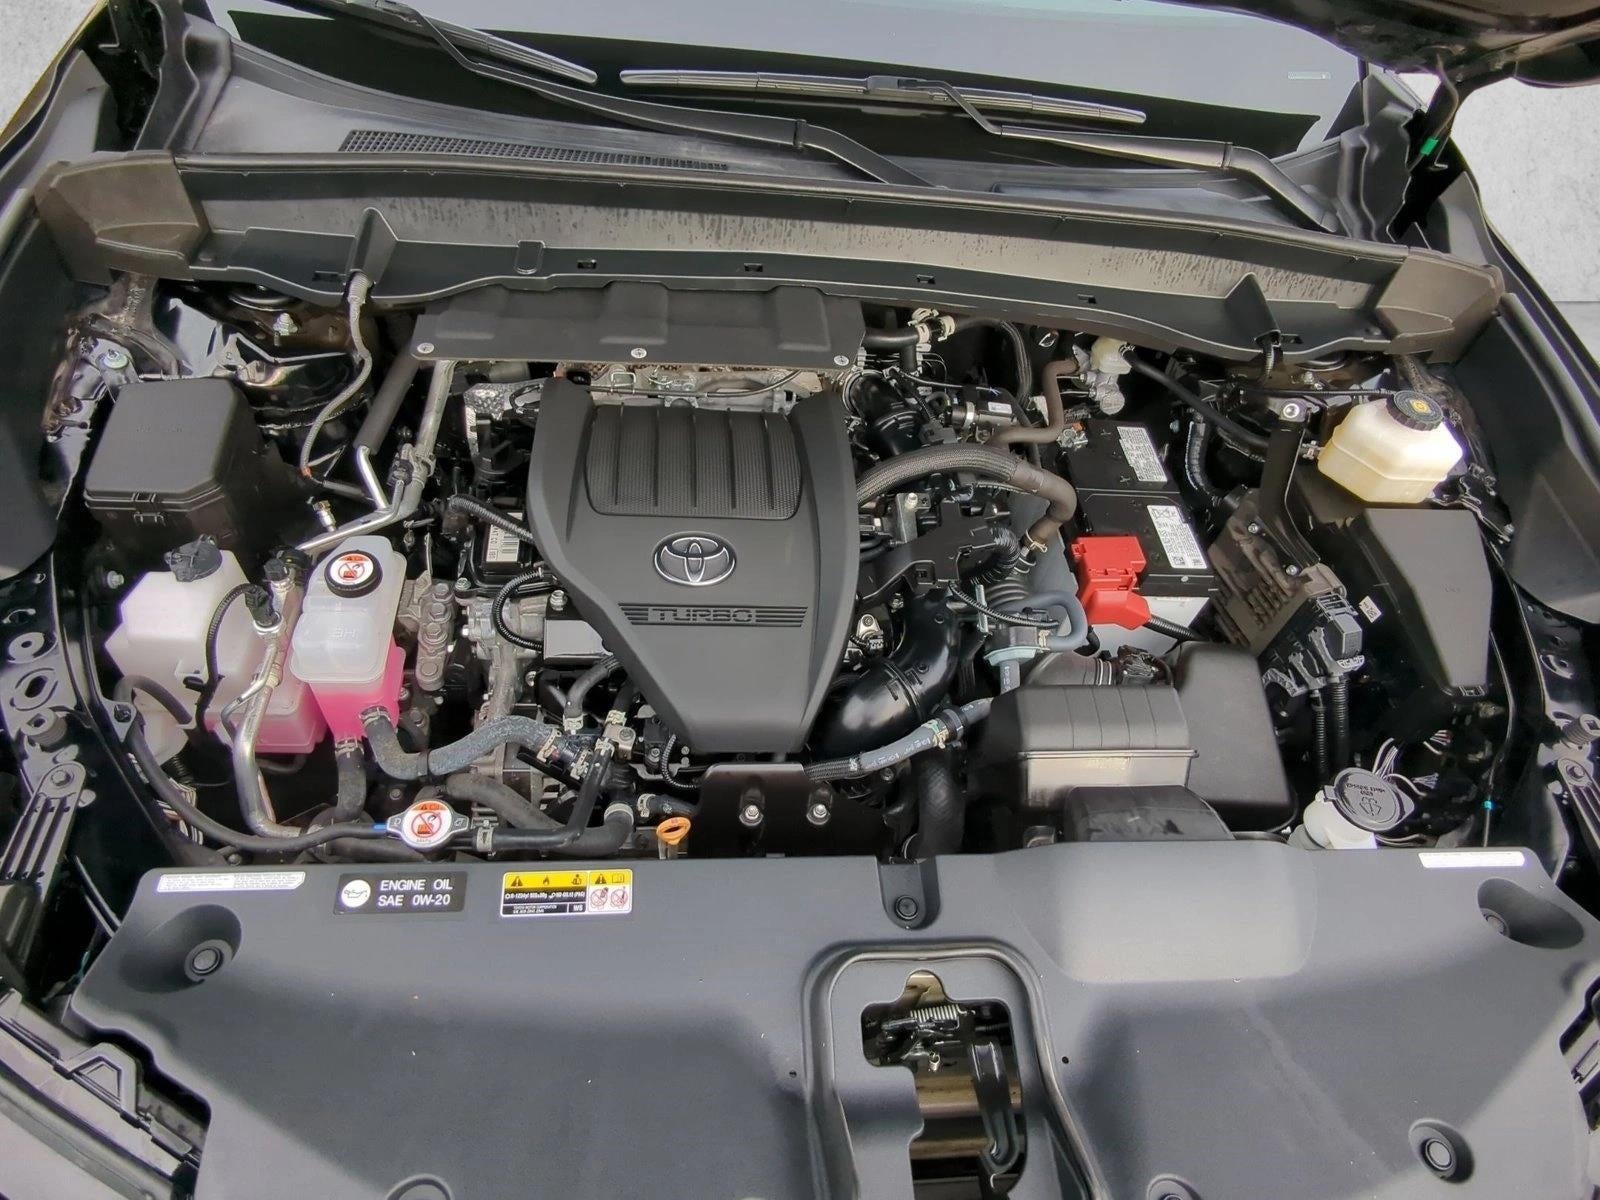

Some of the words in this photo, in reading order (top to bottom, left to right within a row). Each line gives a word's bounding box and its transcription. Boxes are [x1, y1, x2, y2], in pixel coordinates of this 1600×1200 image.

[651, 607, 754, 623] TURBO
[380, 879, 426, 891] ENGINE
[433, 878, 453, 890] OIL
[377, 895, 404, 907] SAE
[412, 893, 451, 906] 0W-20
